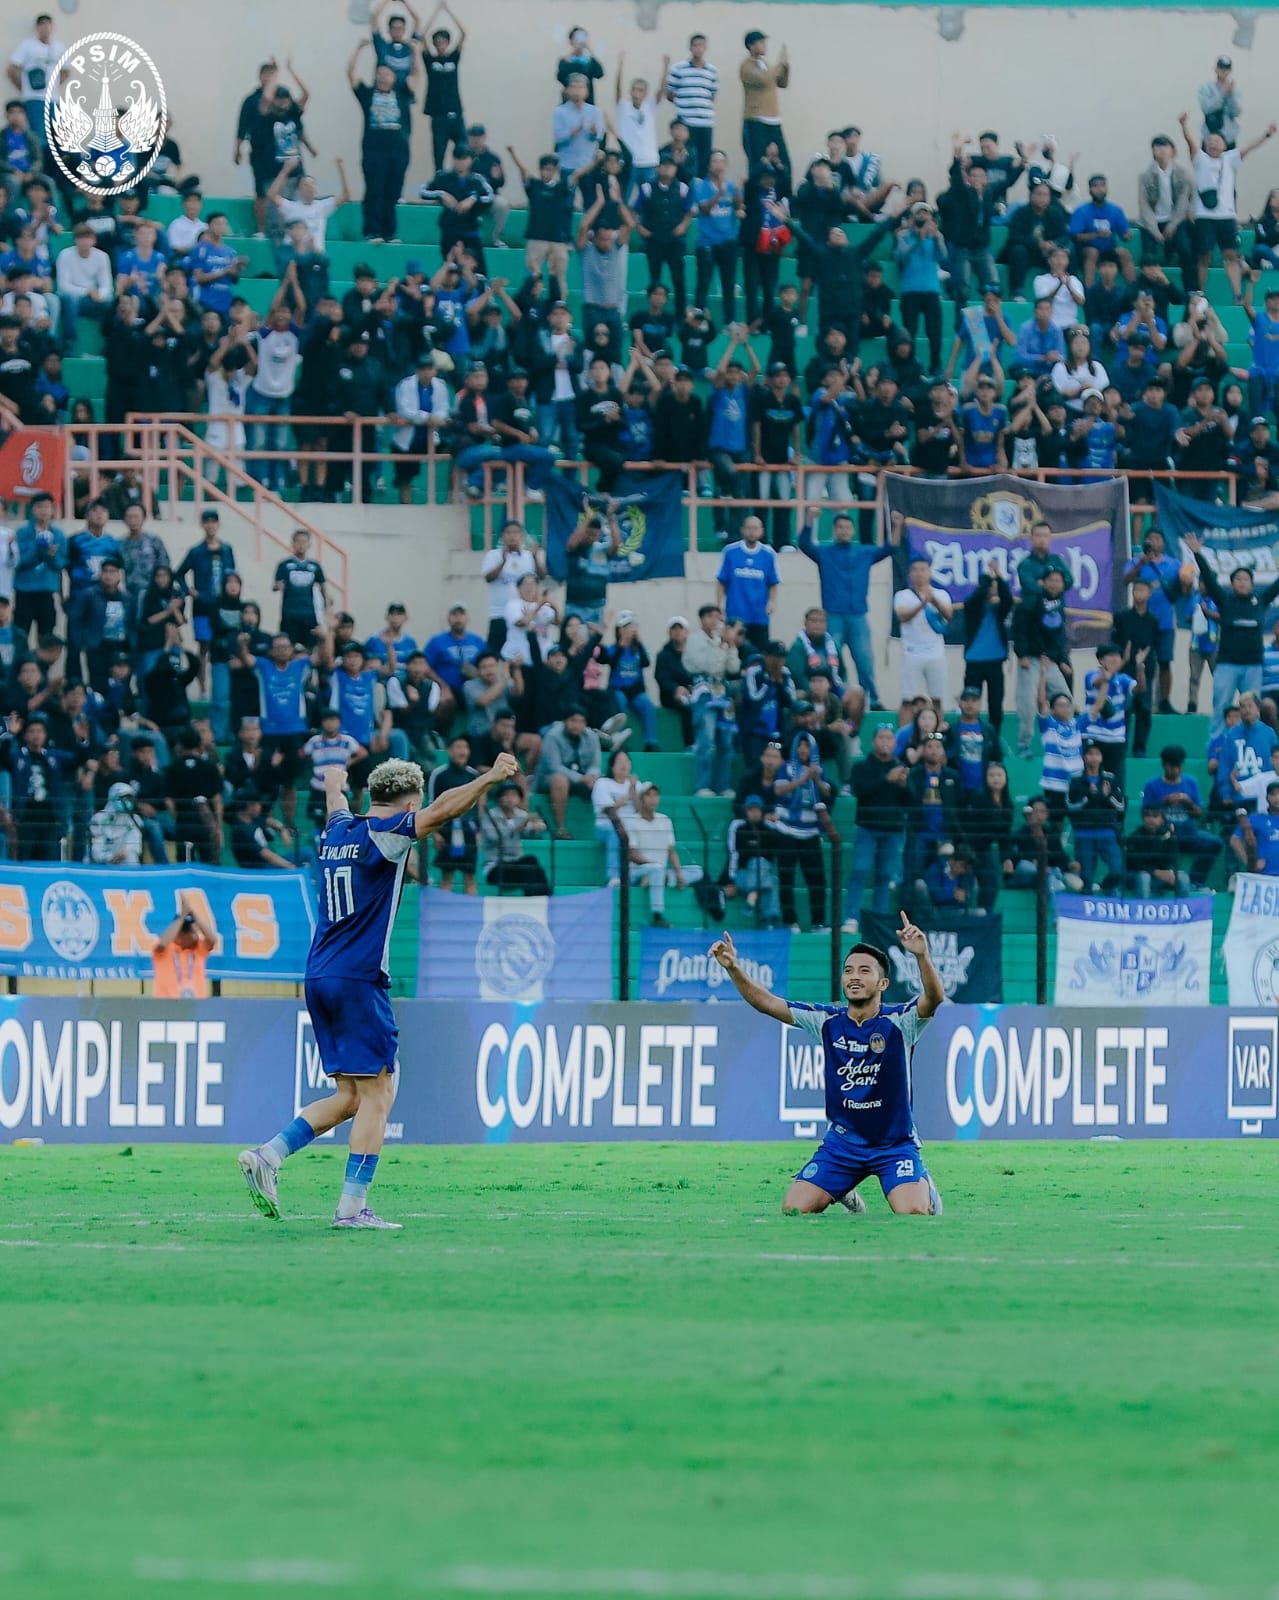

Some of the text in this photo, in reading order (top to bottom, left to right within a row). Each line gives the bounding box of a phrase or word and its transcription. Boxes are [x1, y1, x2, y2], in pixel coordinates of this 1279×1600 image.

[1234, 739, 1263, 776] LA
[324, 866, 355, 921] 10
[1084, 900, 1191, 921] PSIM JOGJA
[476, 1022, 719, 1128] COMPLETE
[789, 1045, 825, 1090] VAR
[946, 1025, 1169, 1127] COMPLETE
[1235, 1044, 1271, 1089] VAR
[848, 1099, 882, 1109] Rexona
[895, 1159, 914, 1174] 29
